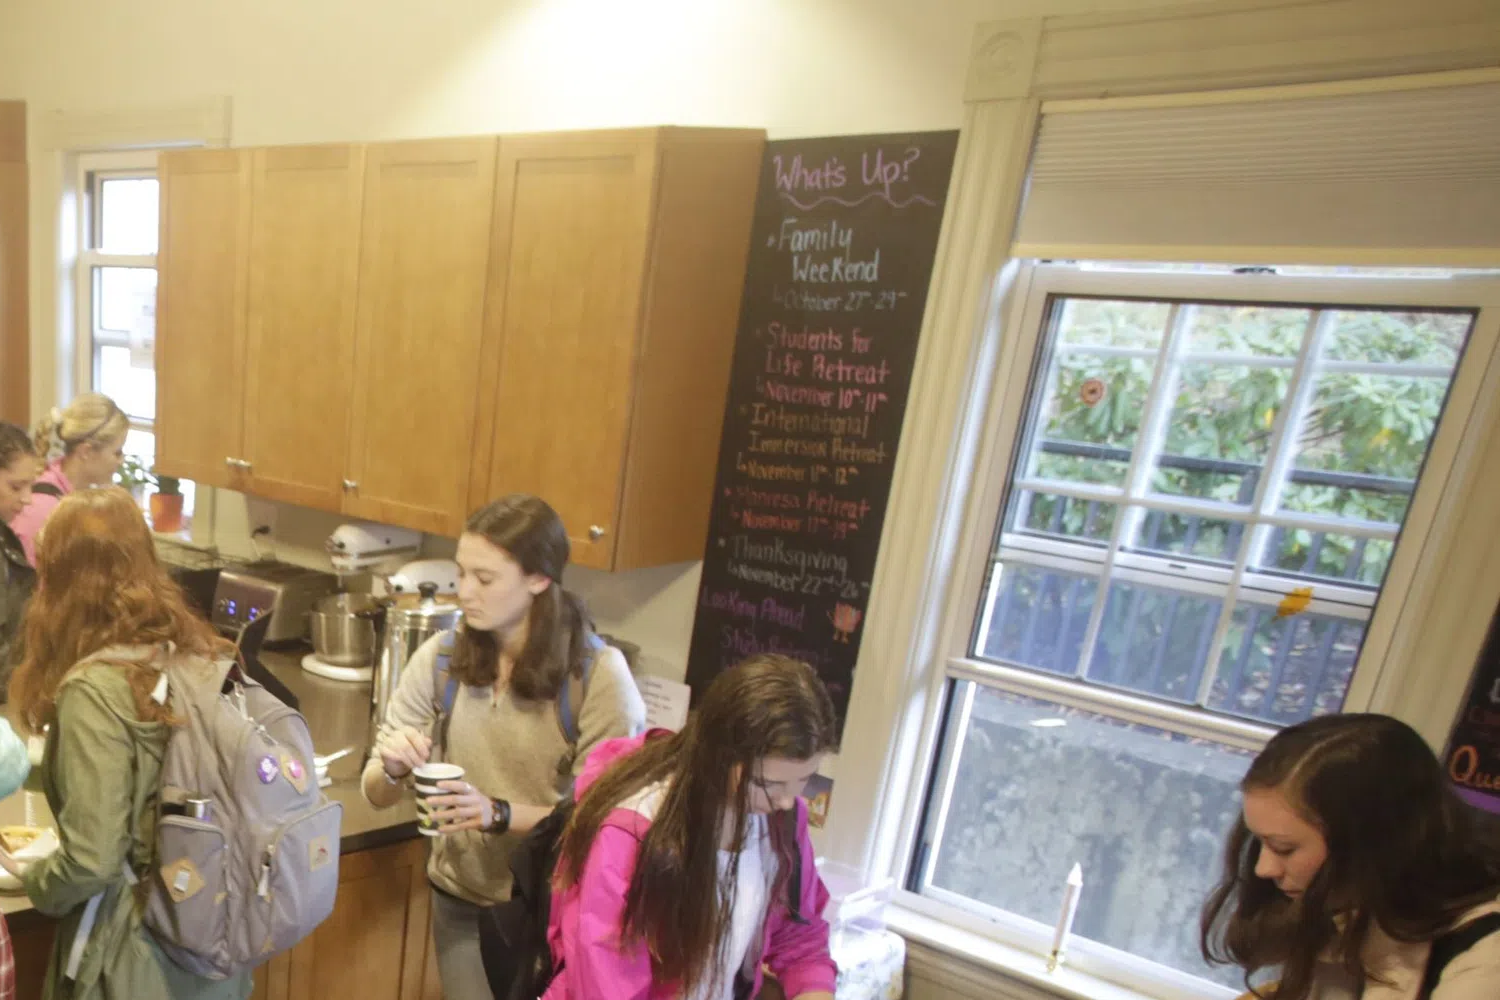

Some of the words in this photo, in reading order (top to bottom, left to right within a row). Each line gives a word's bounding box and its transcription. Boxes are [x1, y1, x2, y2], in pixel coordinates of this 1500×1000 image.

[773, 154, 846, 192] What's
[861, 147, 920, 199] Up?
[778, 217, 853, 263] Family
[783, 288, 841, 310] October
[766, 322, 844, 352] Students
[812, 354, 891, 384] Retreat
[764, 380, 835, 407] November
[752, 404, 869, 439] International
[832, 437, 888, 464] Retreat
[748, 460, 805, 481] November
[806, 490, 870, 521] Retreat
[742, 509, 800, 532] November
[737, 563, 798, 592] November
